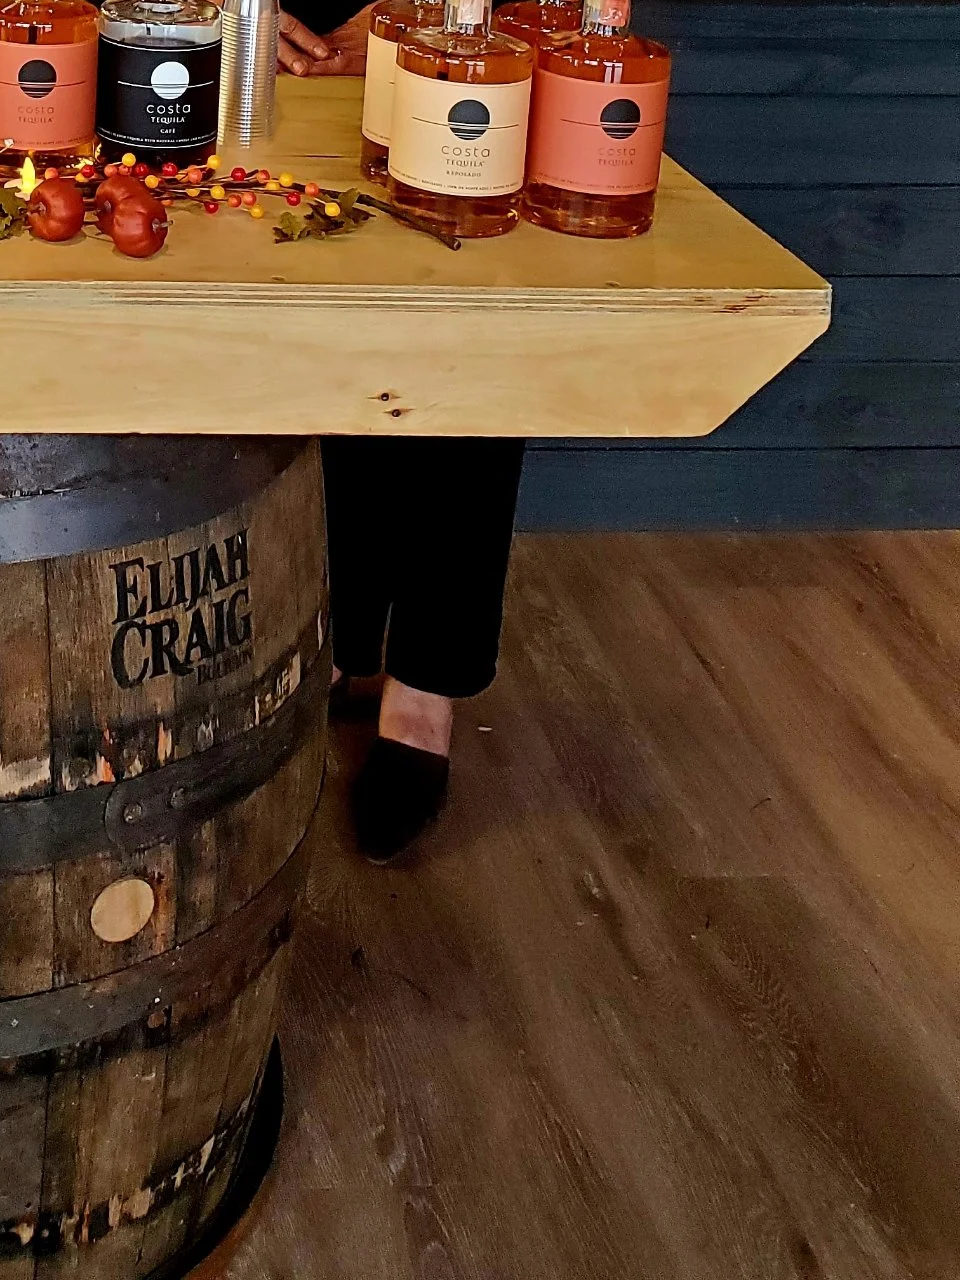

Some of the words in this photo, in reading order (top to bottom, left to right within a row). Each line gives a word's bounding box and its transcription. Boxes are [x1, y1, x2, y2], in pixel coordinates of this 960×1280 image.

[146, 103, 191, 114] costa
[151, 116, 184, 124] TEQUILA
[441, 145, 490, 158] costa
[598, 148, 636, 156] costa
[445, 158, 482, 167] TEQUILA
[108, 528, 250, 625] ELIJAH
[110, 587, 253, 690] CRAIG
